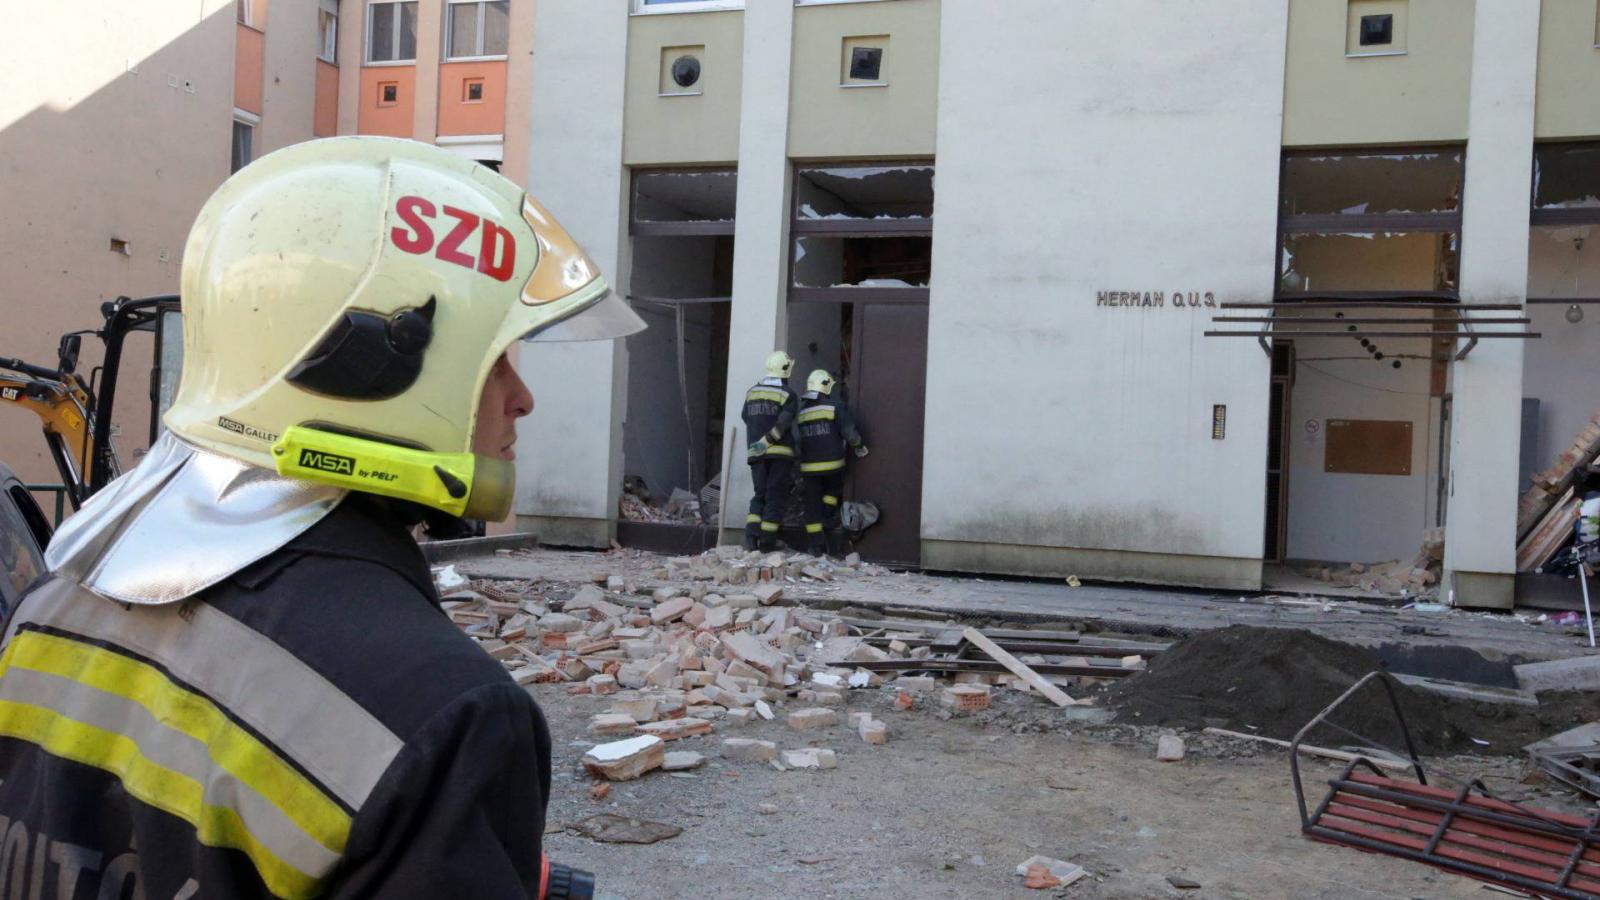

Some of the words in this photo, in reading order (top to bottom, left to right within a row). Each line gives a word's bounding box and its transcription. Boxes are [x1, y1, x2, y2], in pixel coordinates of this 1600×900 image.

[391, 196, 516, 282] SZD
[1097, 292, 1164, 307] HERMAN
[2, 387, 18, 400] CAT
[219, 417, 244, 434] MSA
[245, 427, 279, 442] GALLET
[301, 451, 352, 474] MSA
[358, 469, 370, 478] by
